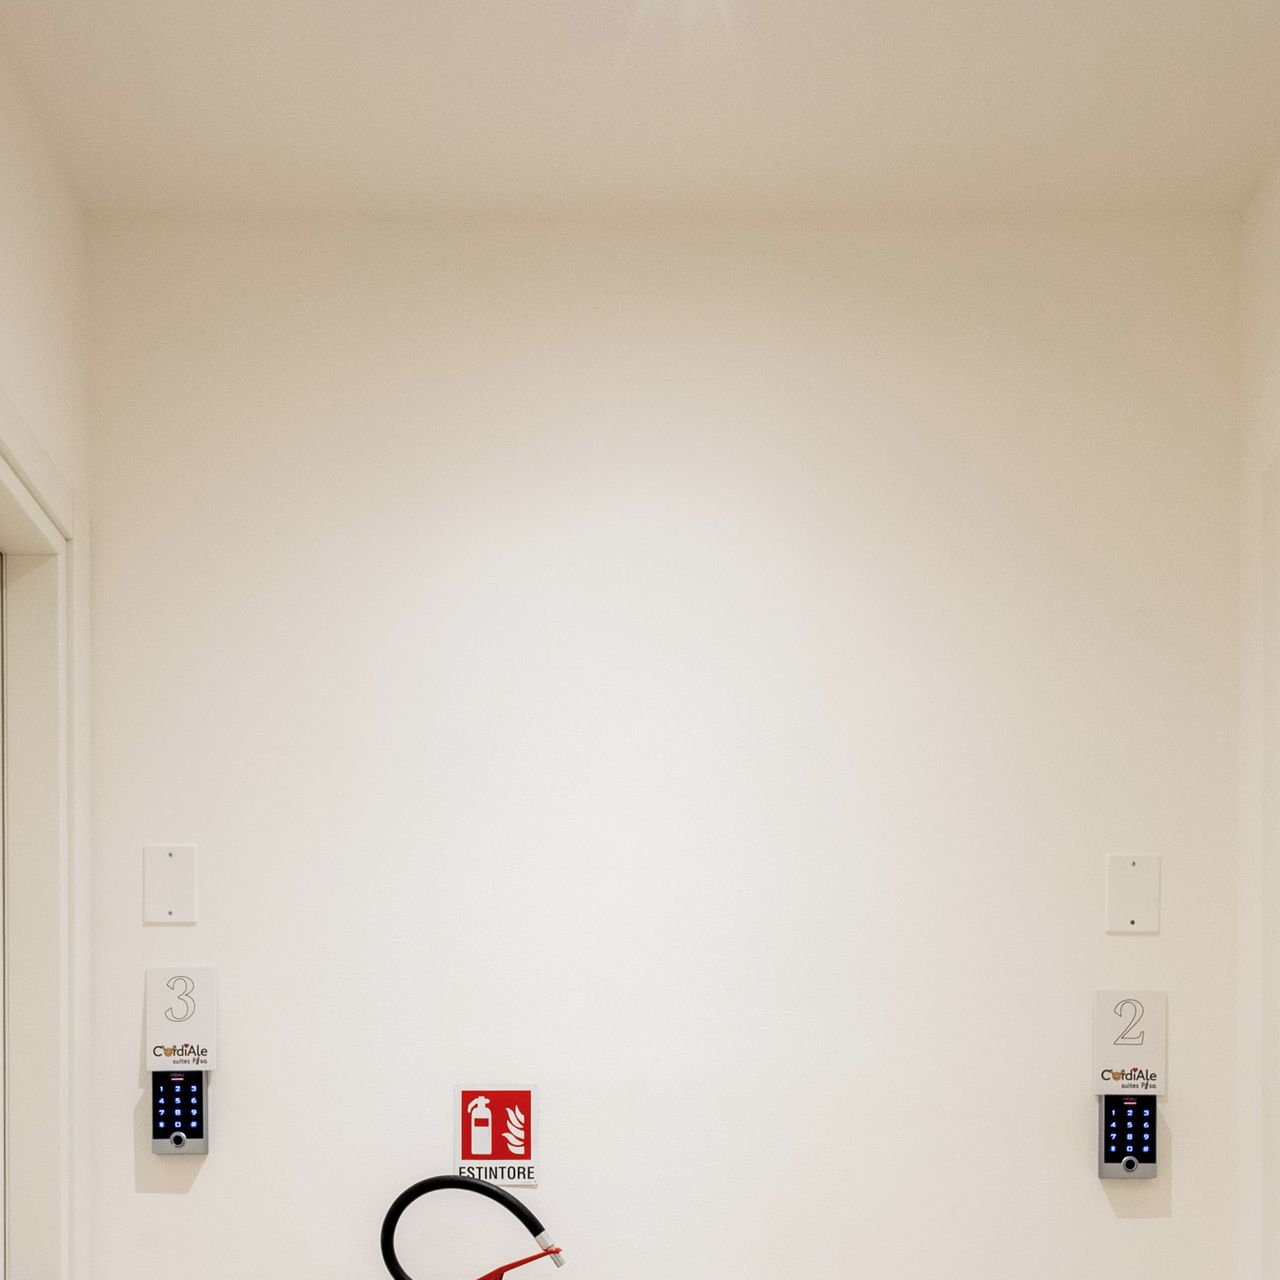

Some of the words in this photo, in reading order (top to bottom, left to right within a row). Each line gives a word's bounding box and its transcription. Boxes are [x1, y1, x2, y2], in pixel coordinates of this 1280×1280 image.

[164, 975, 196, 1023] 3
[1113, 998, 1145, 1046] 2
[459, 1166, 535, 1180] ESTINTORE
